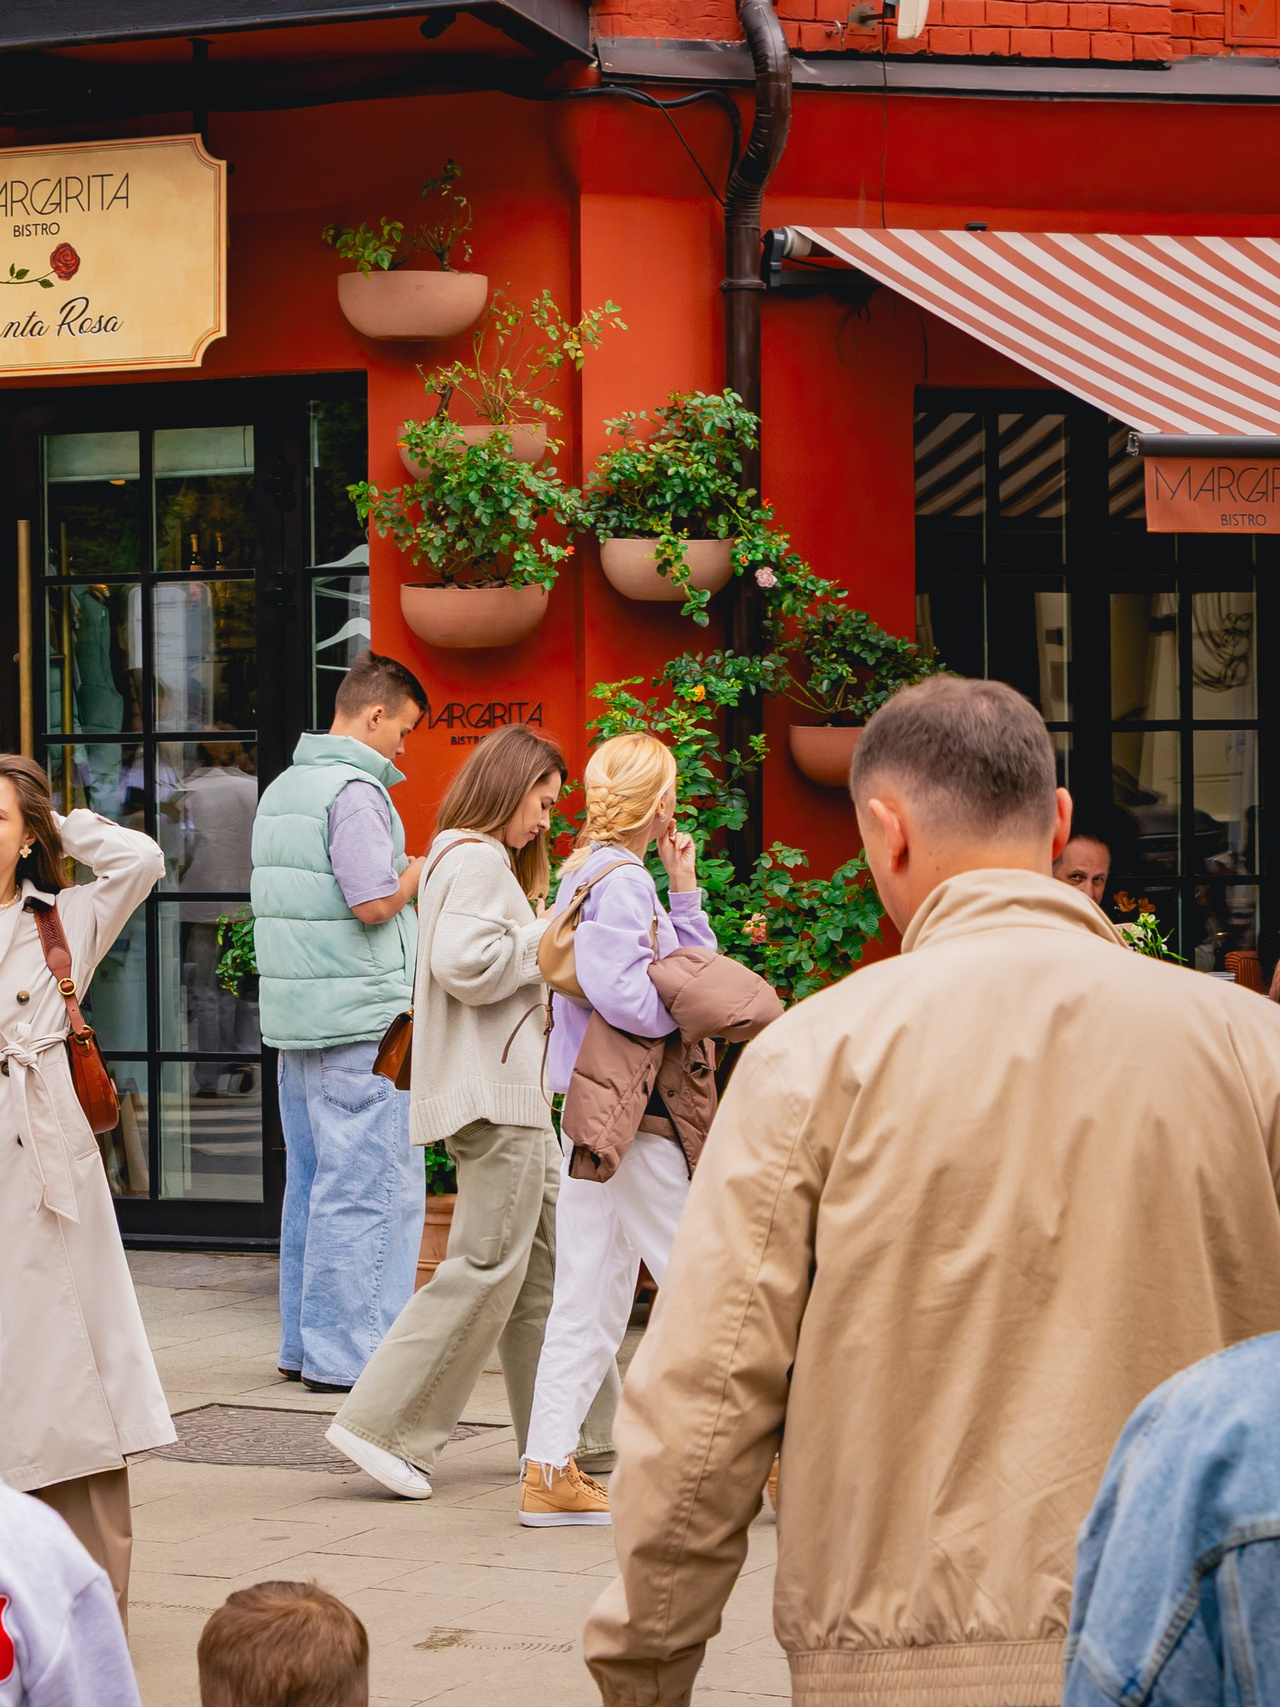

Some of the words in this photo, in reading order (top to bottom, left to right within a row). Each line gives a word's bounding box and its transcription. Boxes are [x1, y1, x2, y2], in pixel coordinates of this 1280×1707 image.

[12, 222, 61, 238] BISTRO
[56, 296, 125, 338] Rosa
[1221, 513, 1267, 527] BISTRO
